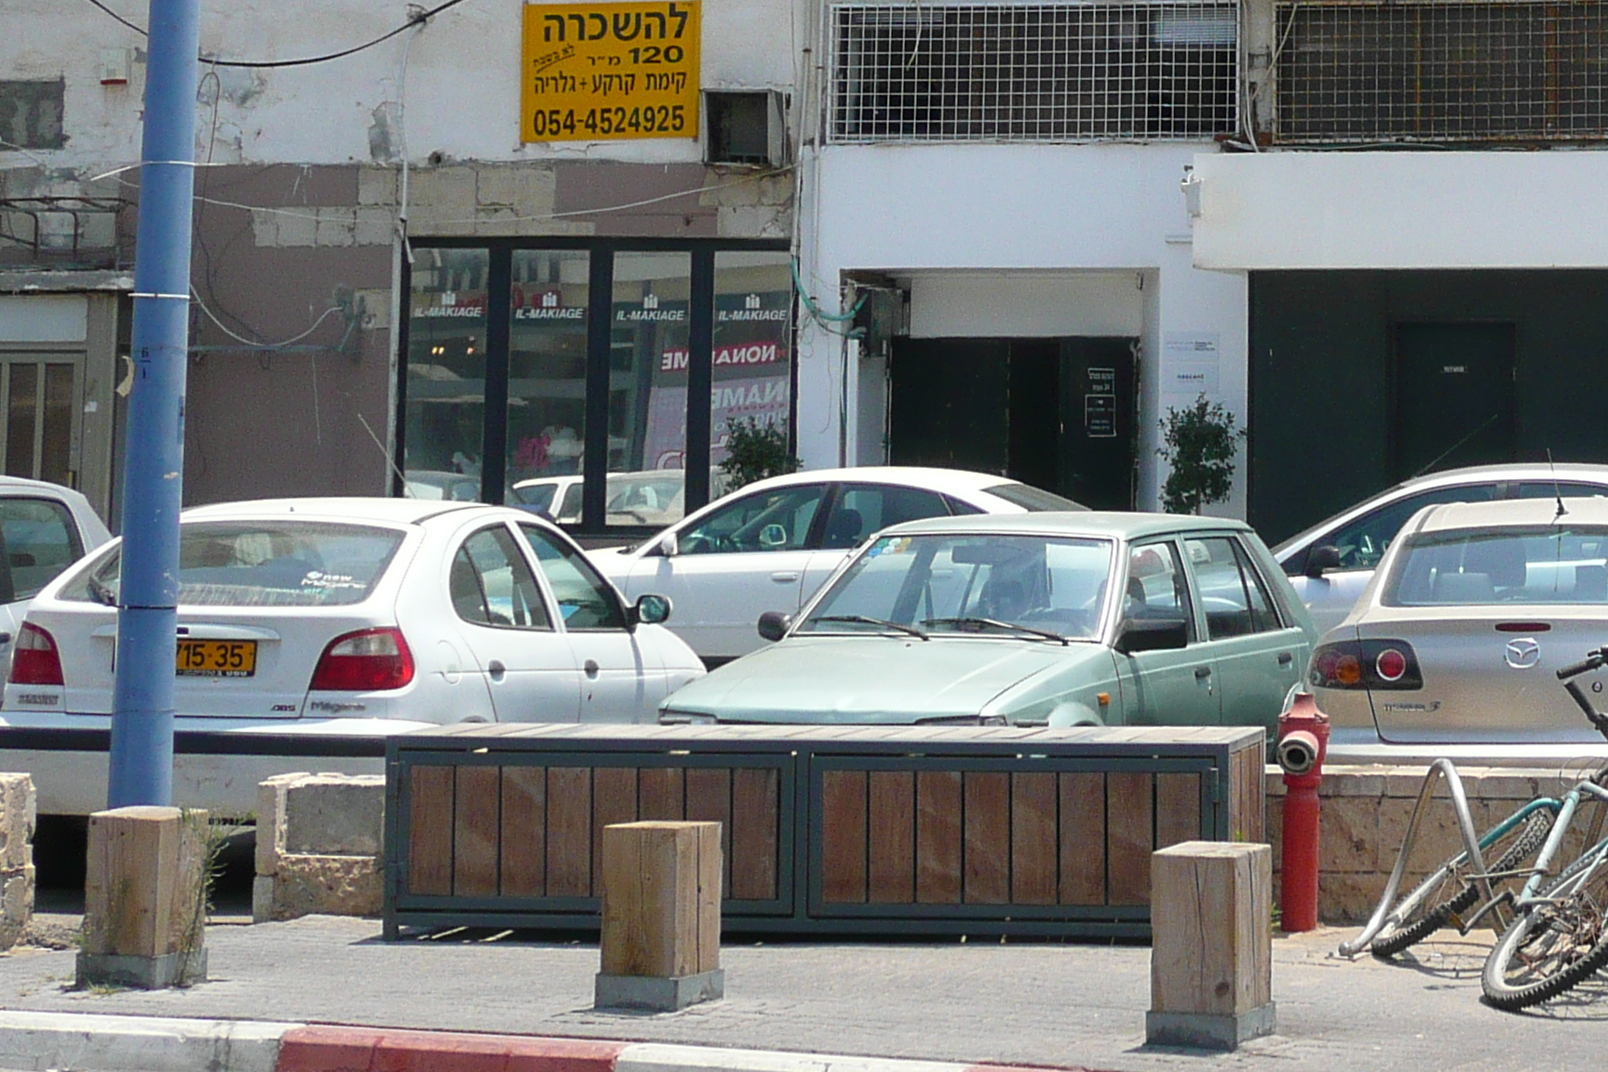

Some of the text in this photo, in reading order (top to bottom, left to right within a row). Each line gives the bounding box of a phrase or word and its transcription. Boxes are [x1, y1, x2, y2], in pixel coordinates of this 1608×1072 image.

[543, 2, 689, 42] להשכרה
[628, 45, 684, 64] 120
[533, 105, 685, 136] 054-4524925
[414, 307, 482, 317] IL-MAKIAGE
[515, 308, 584, 319] IL-MAKIAGE
[616, 310, 685, 321] IL-MAKIAGE
[718, 310, 788, 321] IL-MAKIAGE
